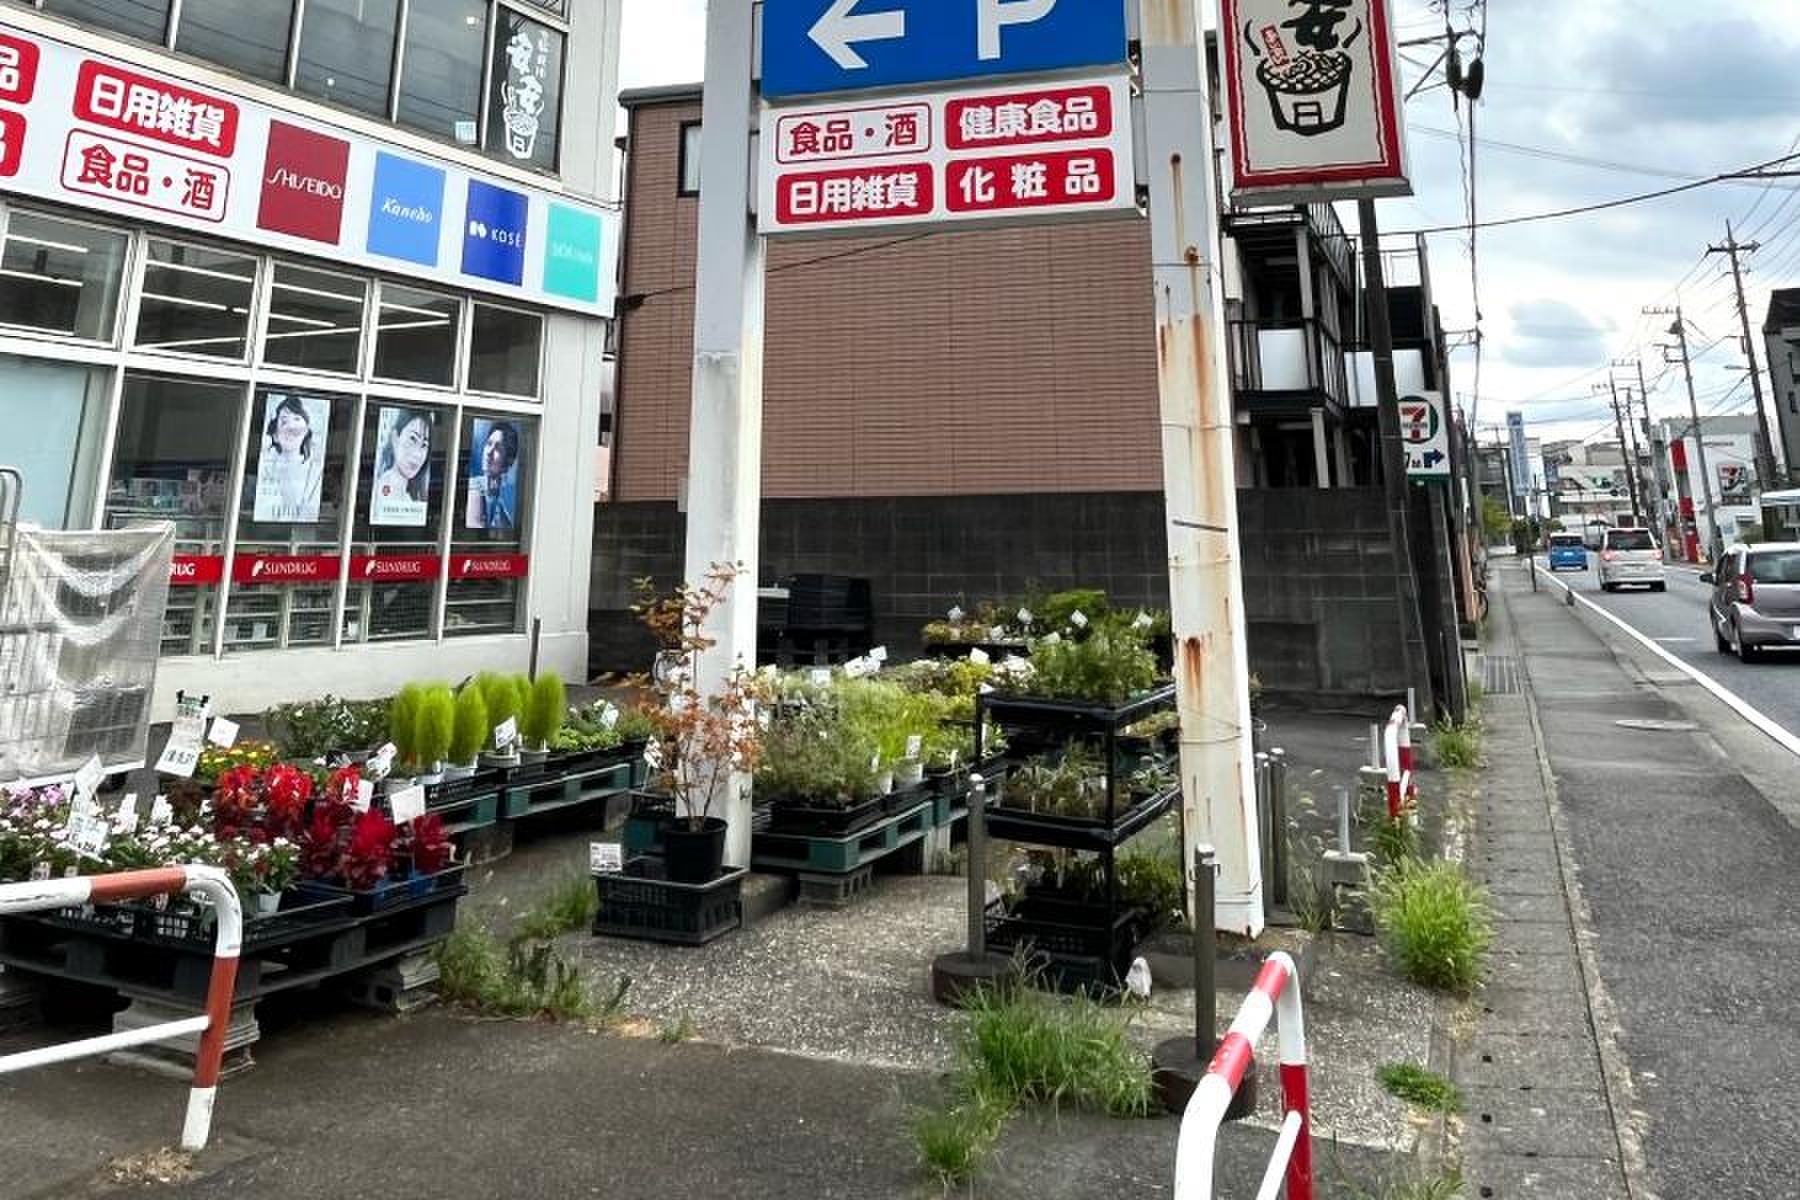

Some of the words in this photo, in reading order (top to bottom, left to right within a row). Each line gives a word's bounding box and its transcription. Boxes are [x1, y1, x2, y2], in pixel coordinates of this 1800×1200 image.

[89, 73, 225, 147] 日用雑貨
[959, 95, 1098, 141] 健康食品
[788, 112, 918, 157] 食品・酒
[77, 143, 217, 211] 食品・酒
[266, 167, 342, 200] SHISEIDO
[789, 171, 919, 216] 日用雑貨
[959, 158, 1101, 204] 化粧品
[382, 197, 433, 224] Kanebo
[264, 560, 317, 576] SUNDRUG
[375, 560, 421, 574] SUNDRUG
